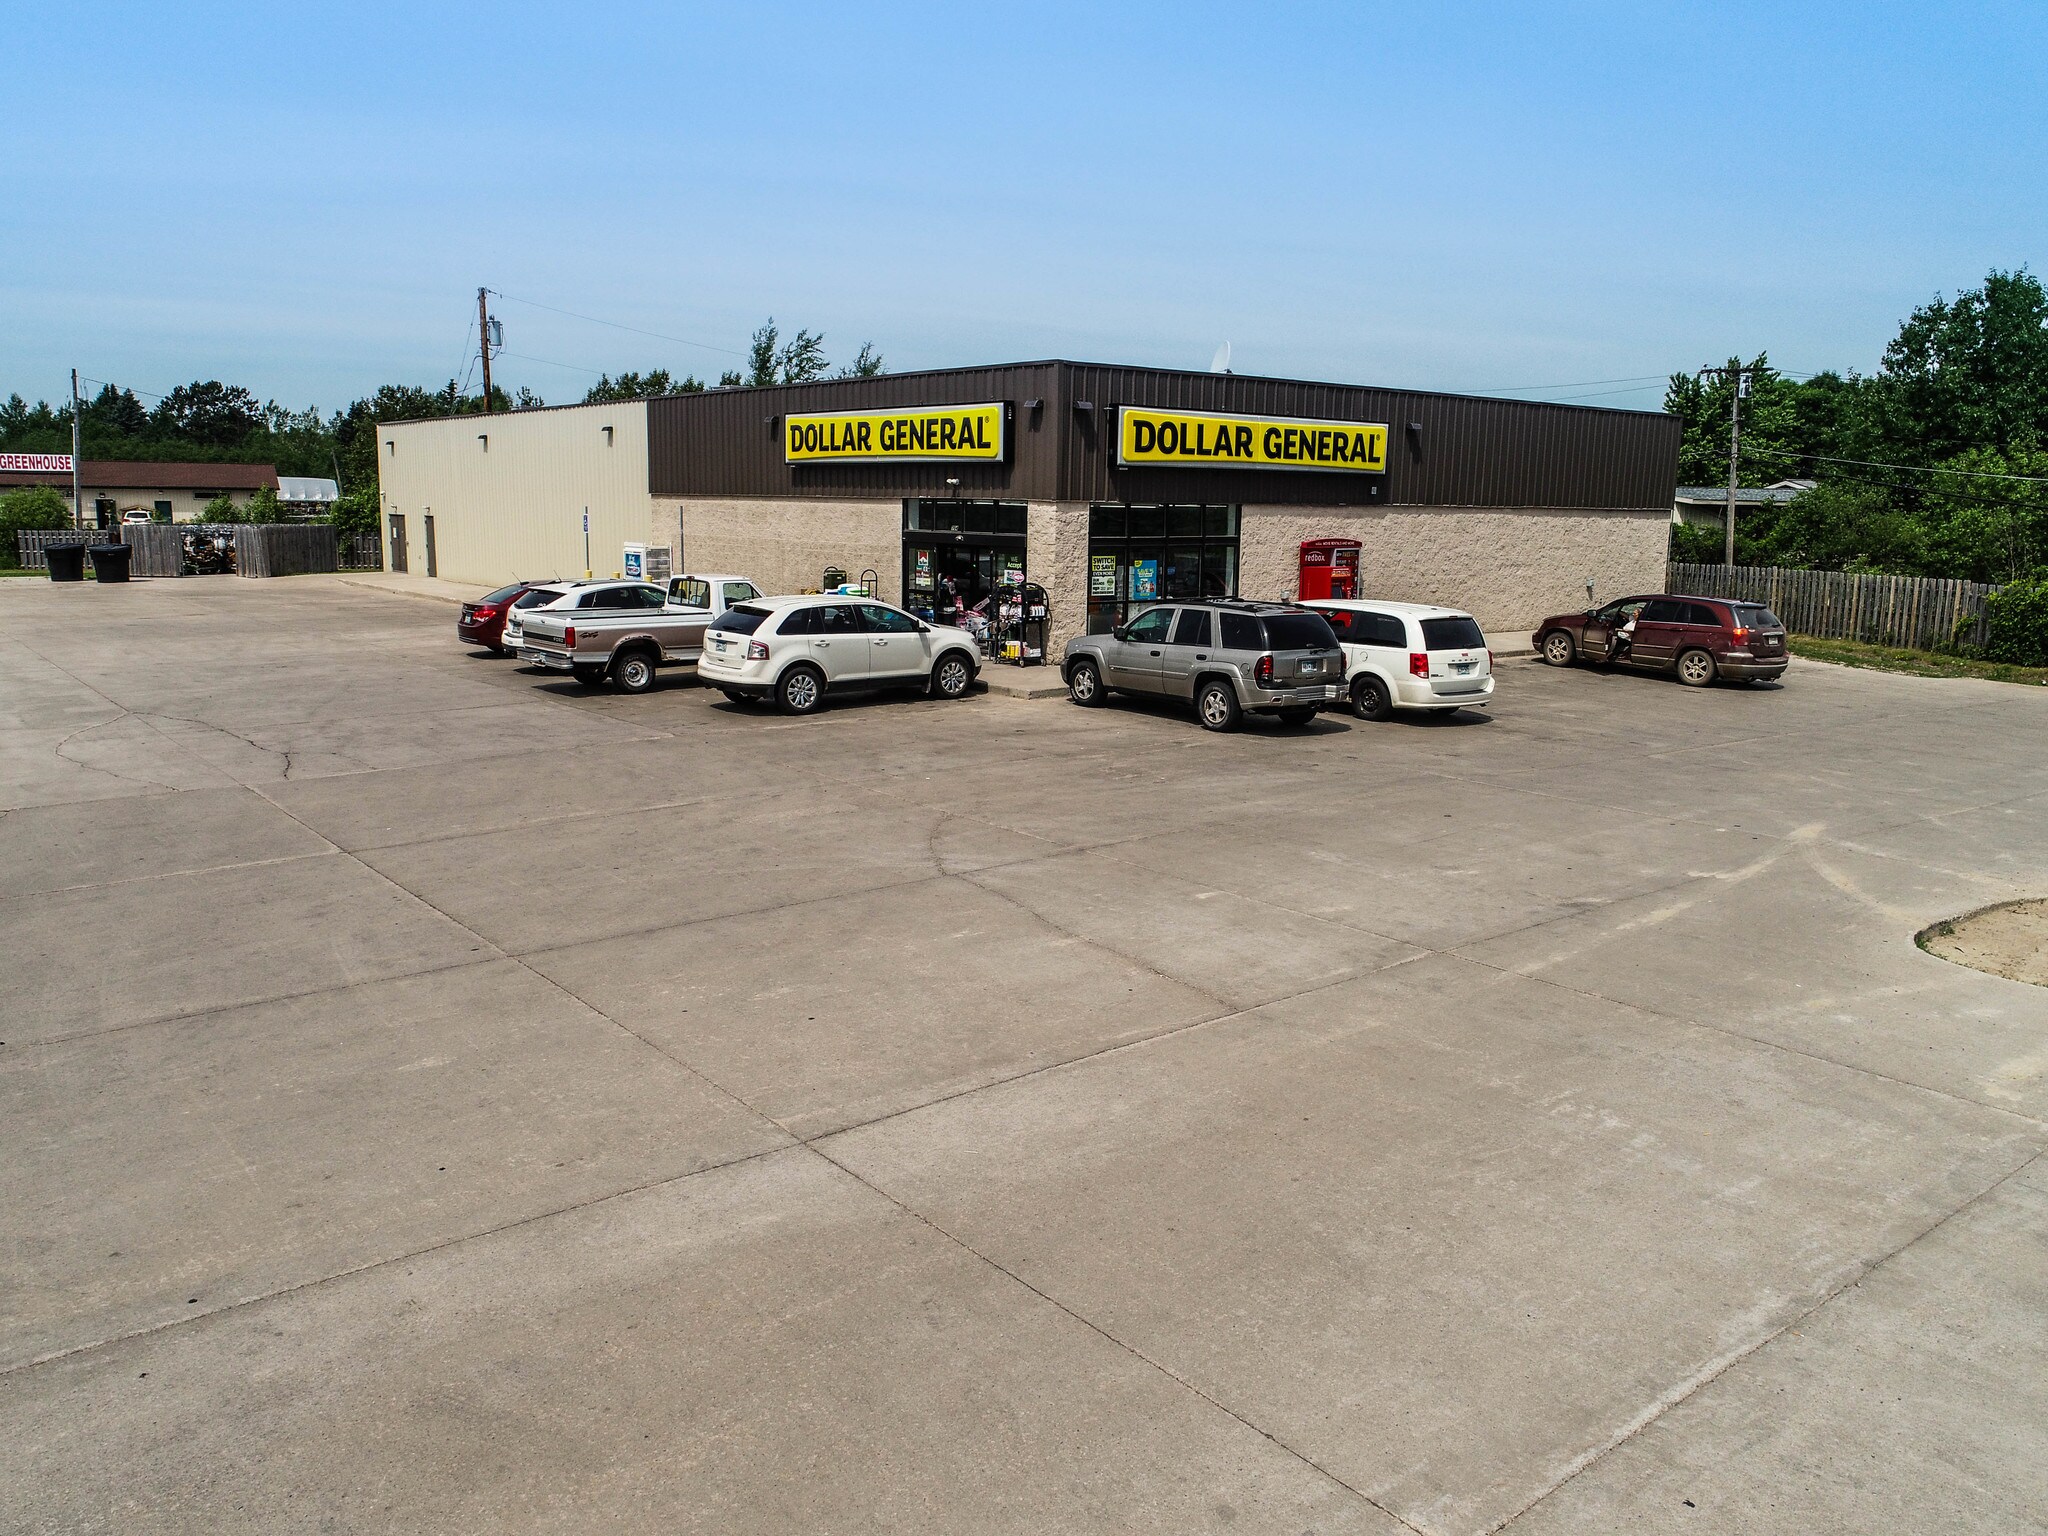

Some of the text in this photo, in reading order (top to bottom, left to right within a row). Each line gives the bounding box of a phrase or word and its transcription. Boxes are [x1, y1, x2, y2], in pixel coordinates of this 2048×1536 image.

[790, 416, 991, 453] DOLLAR GENERAL
[1133, 420, 1381, 463] DOLLAR GENERAL
[0, 455, 72, 470] GREENHOUSE
[1305, 553, 1325, 561] redbox
